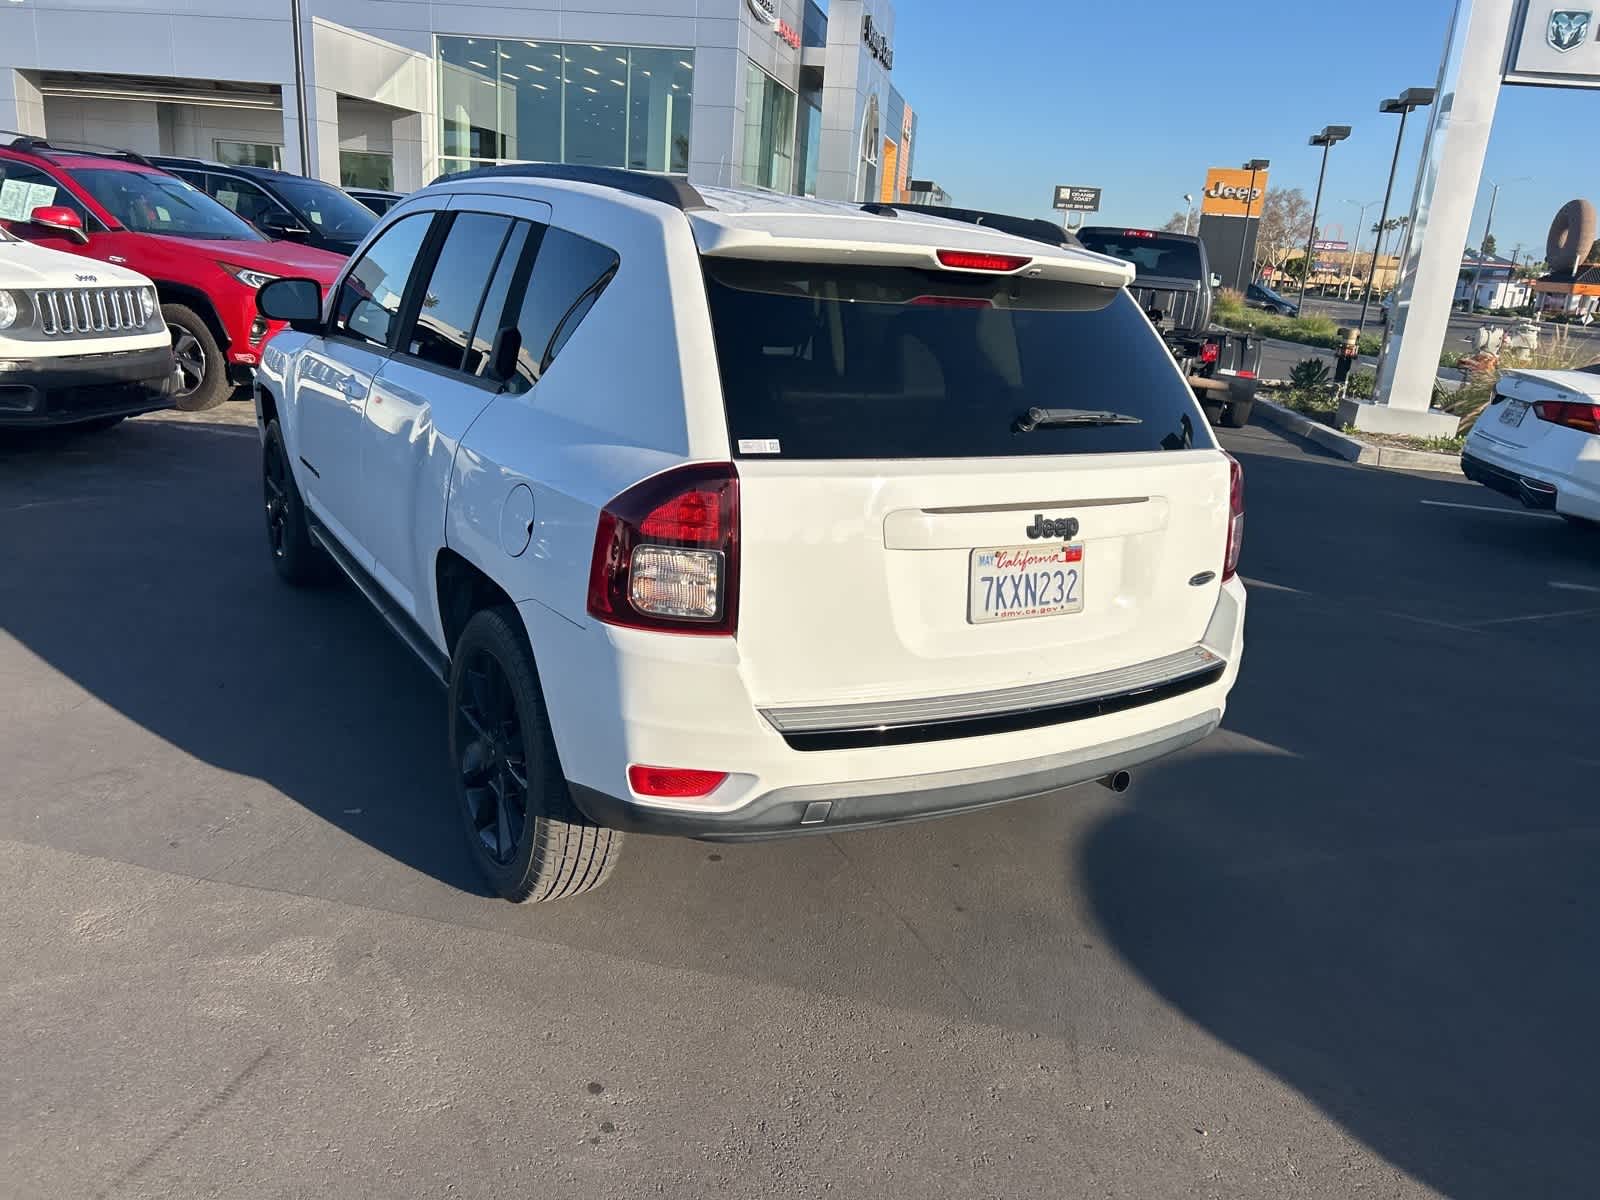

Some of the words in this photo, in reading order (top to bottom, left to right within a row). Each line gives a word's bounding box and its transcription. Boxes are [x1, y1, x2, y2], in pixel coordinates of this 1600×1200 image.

[1206, 181, 1262, 203] Jeep
[1026, 514, 1080, 541] Jeep
[978, 555, 995, 567] MAY
[995, 550, 1066, 571] California
[980, 568, 1079, 612] 7KXN232
[1000, 606, 1059, 618] dmv.ca.gov
